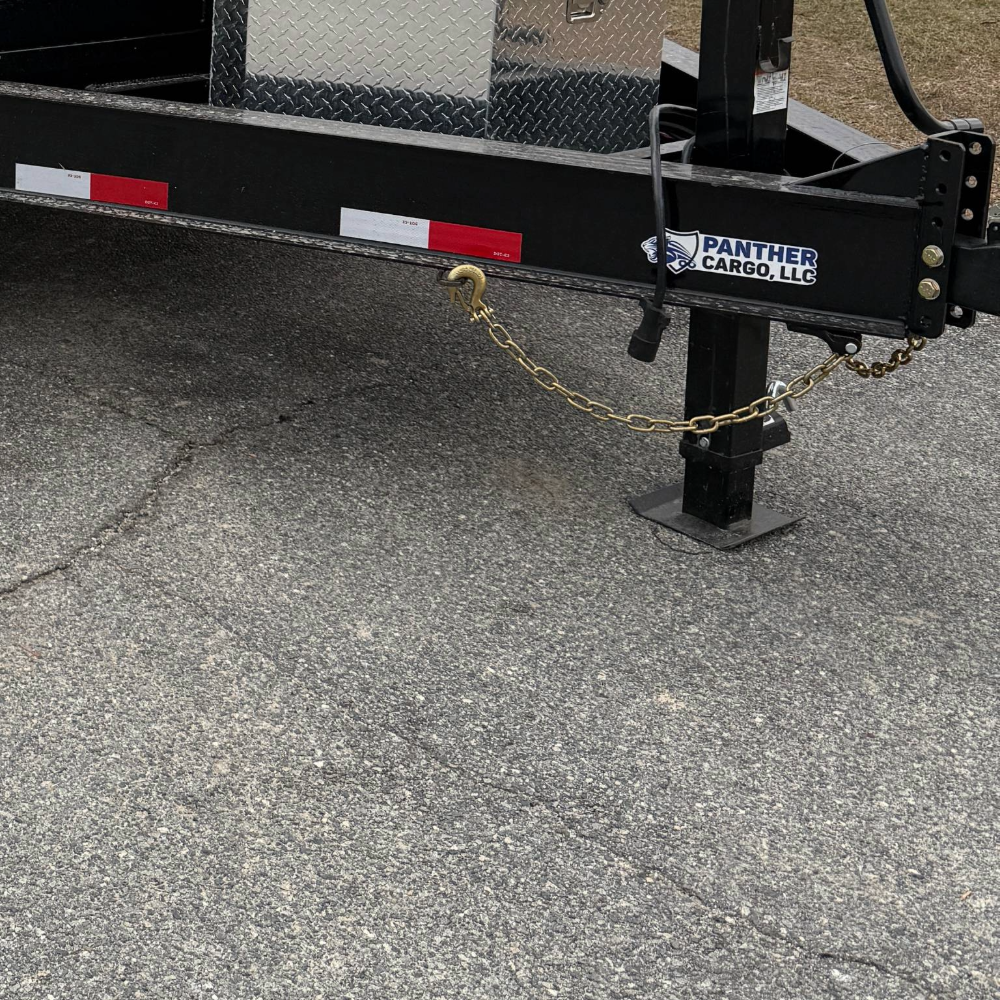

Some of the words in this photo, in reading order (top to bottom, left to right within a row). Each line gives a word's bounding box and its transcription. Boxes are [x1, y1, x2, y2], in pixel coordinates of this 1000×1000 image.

[702, 236, 816, 267] PANTHER
[702, 255, 775, 281] CARGO,
[779, 265, 816, 284] LLC
